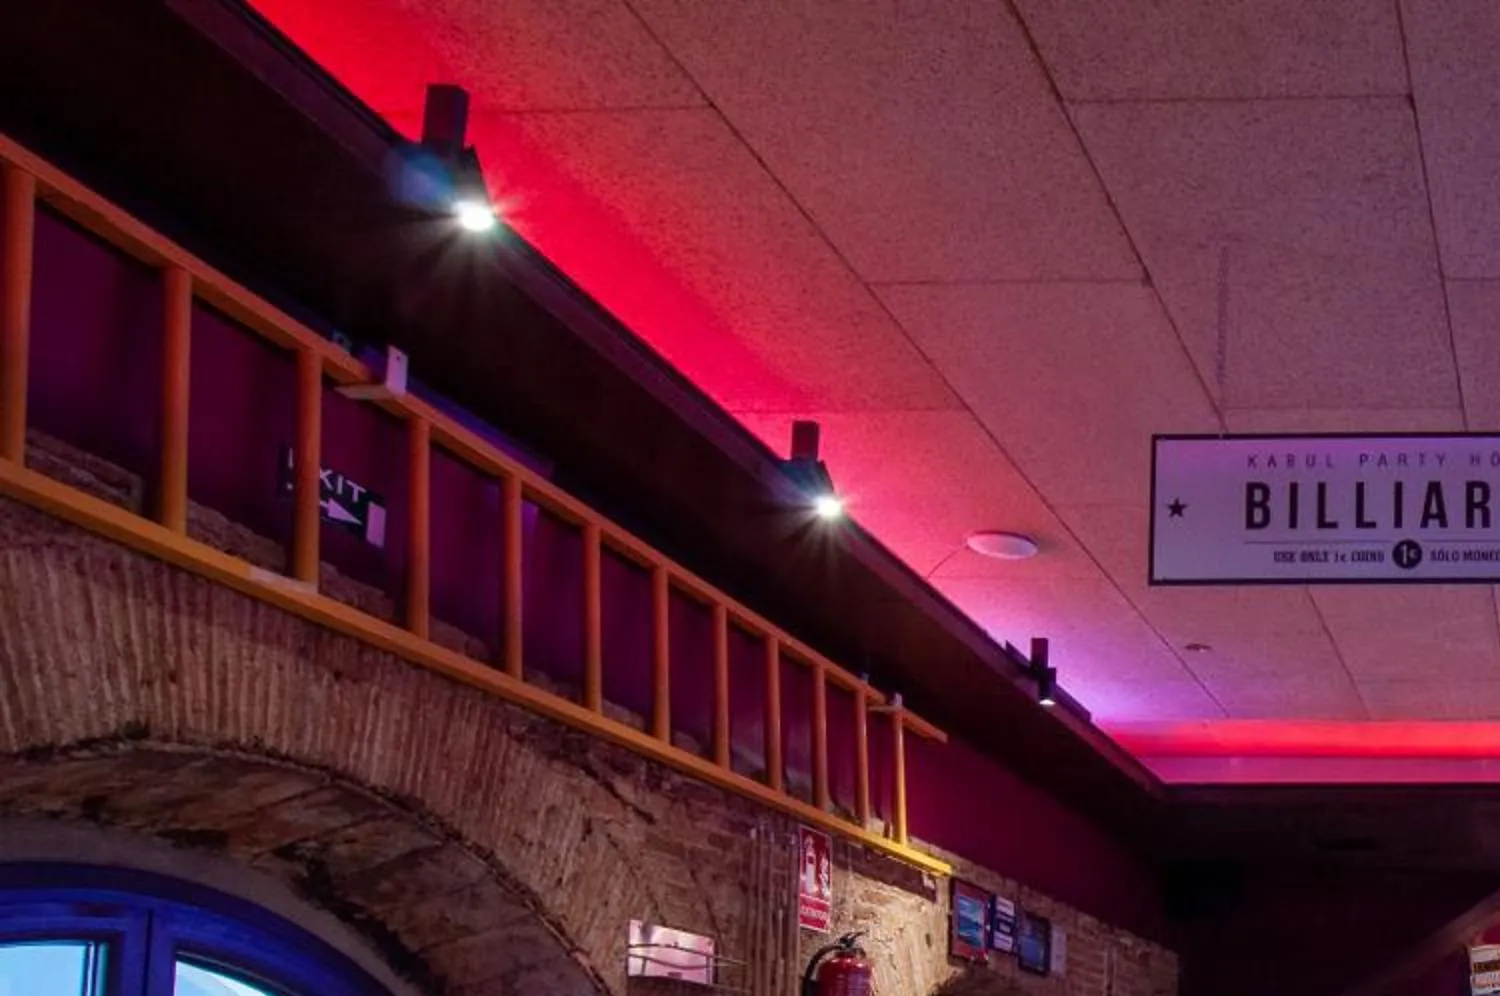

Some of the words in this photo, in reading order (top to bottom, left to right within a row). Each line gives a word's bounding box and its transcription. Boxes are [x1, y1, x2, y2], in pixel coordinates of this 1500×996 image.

[1247, 453, 1334, 468] KABUL
[1359, 452, 1447, 467] PARTY
[319, 467, 368, 503] XIT
